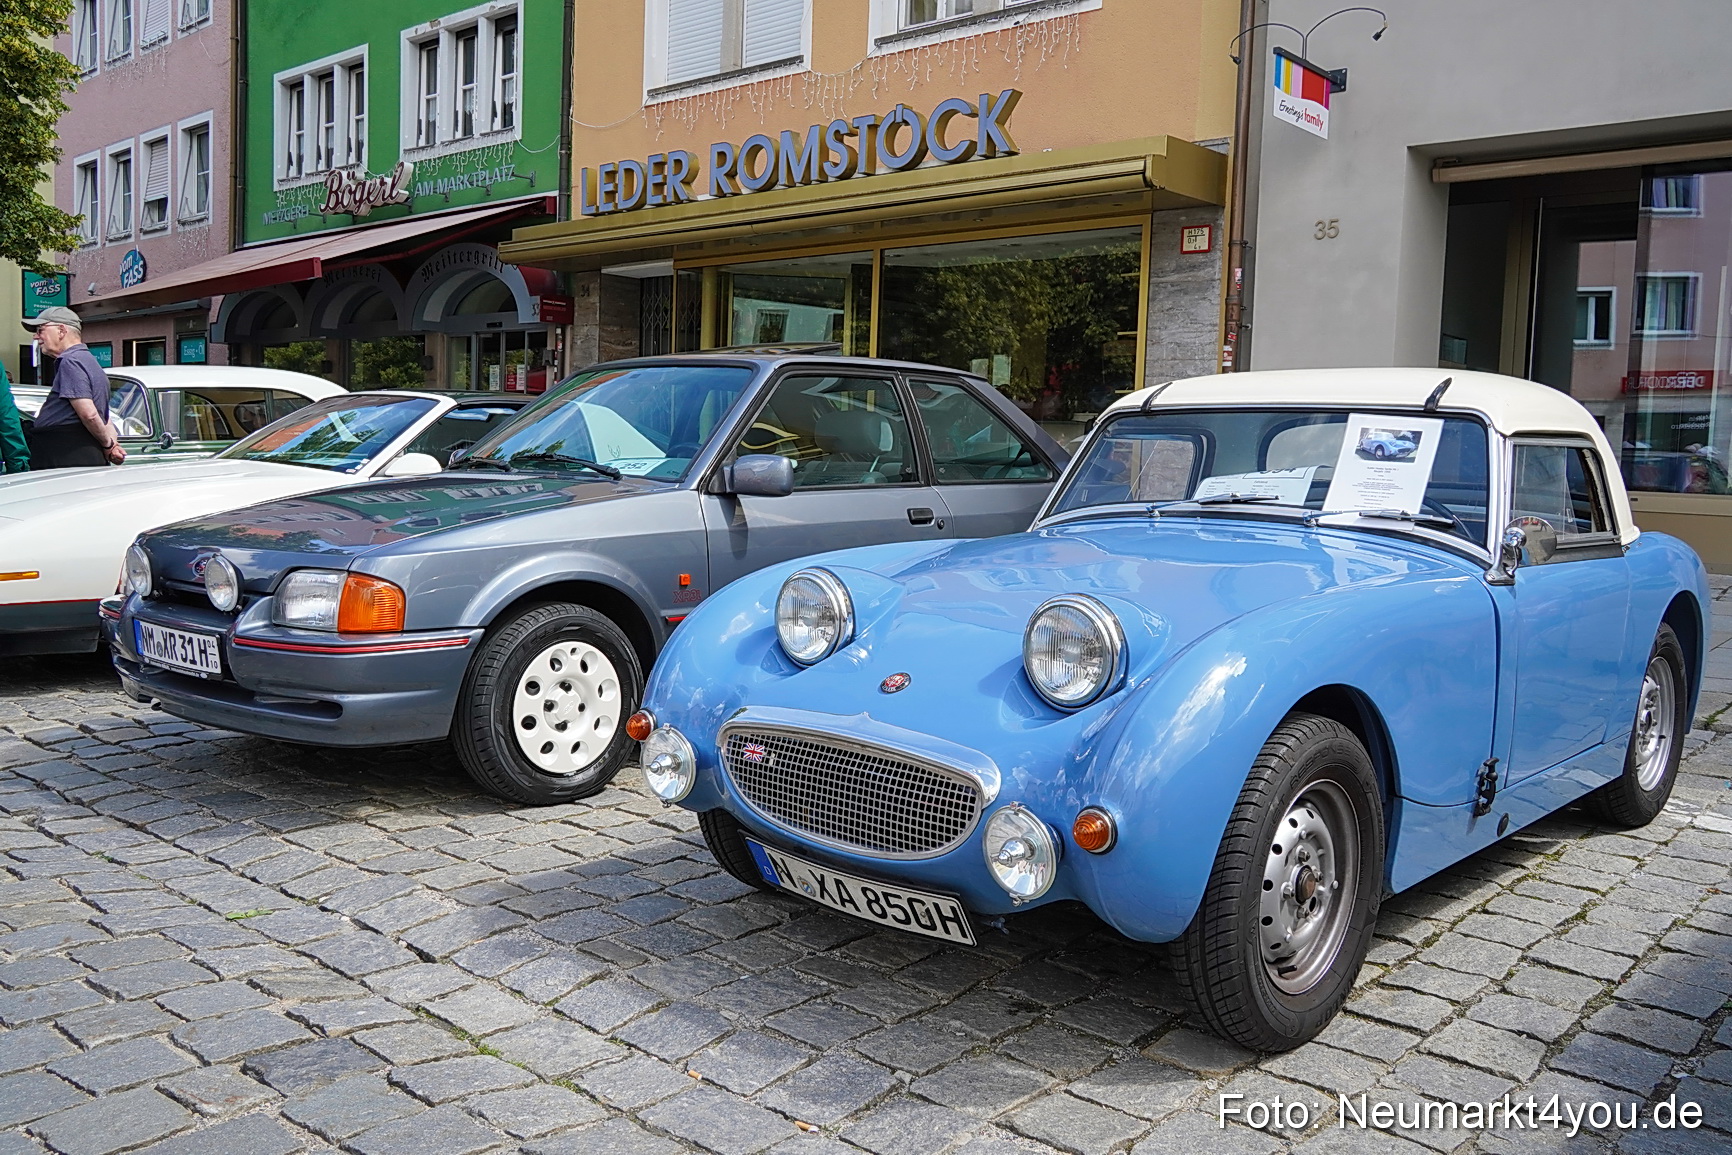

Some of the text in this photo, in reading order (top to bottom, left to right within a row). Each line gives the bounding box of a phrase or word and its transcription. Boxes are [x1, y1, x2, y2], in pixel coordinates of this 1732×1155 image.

[1304, 107, 1325, 131] family
[581, 88, 1023, 217] LEDER ROMSTÖCK
[318, 160, 408, 217] Bögerl
[414, 163, 516, 198] AM MARKTPLATZ
[262, 204, 310, 227] METZGEREI
[1314, 218, 1340, 241] 35
[30, 280, 48, 289] vom
[123, 260, 144, 289] FASS
[35, 283, 61, 297] FASS
[140, 624, 157, 656] NM
[161, 630, 179, 662] XR
[768, 852, 969, 940] N XA 850H
